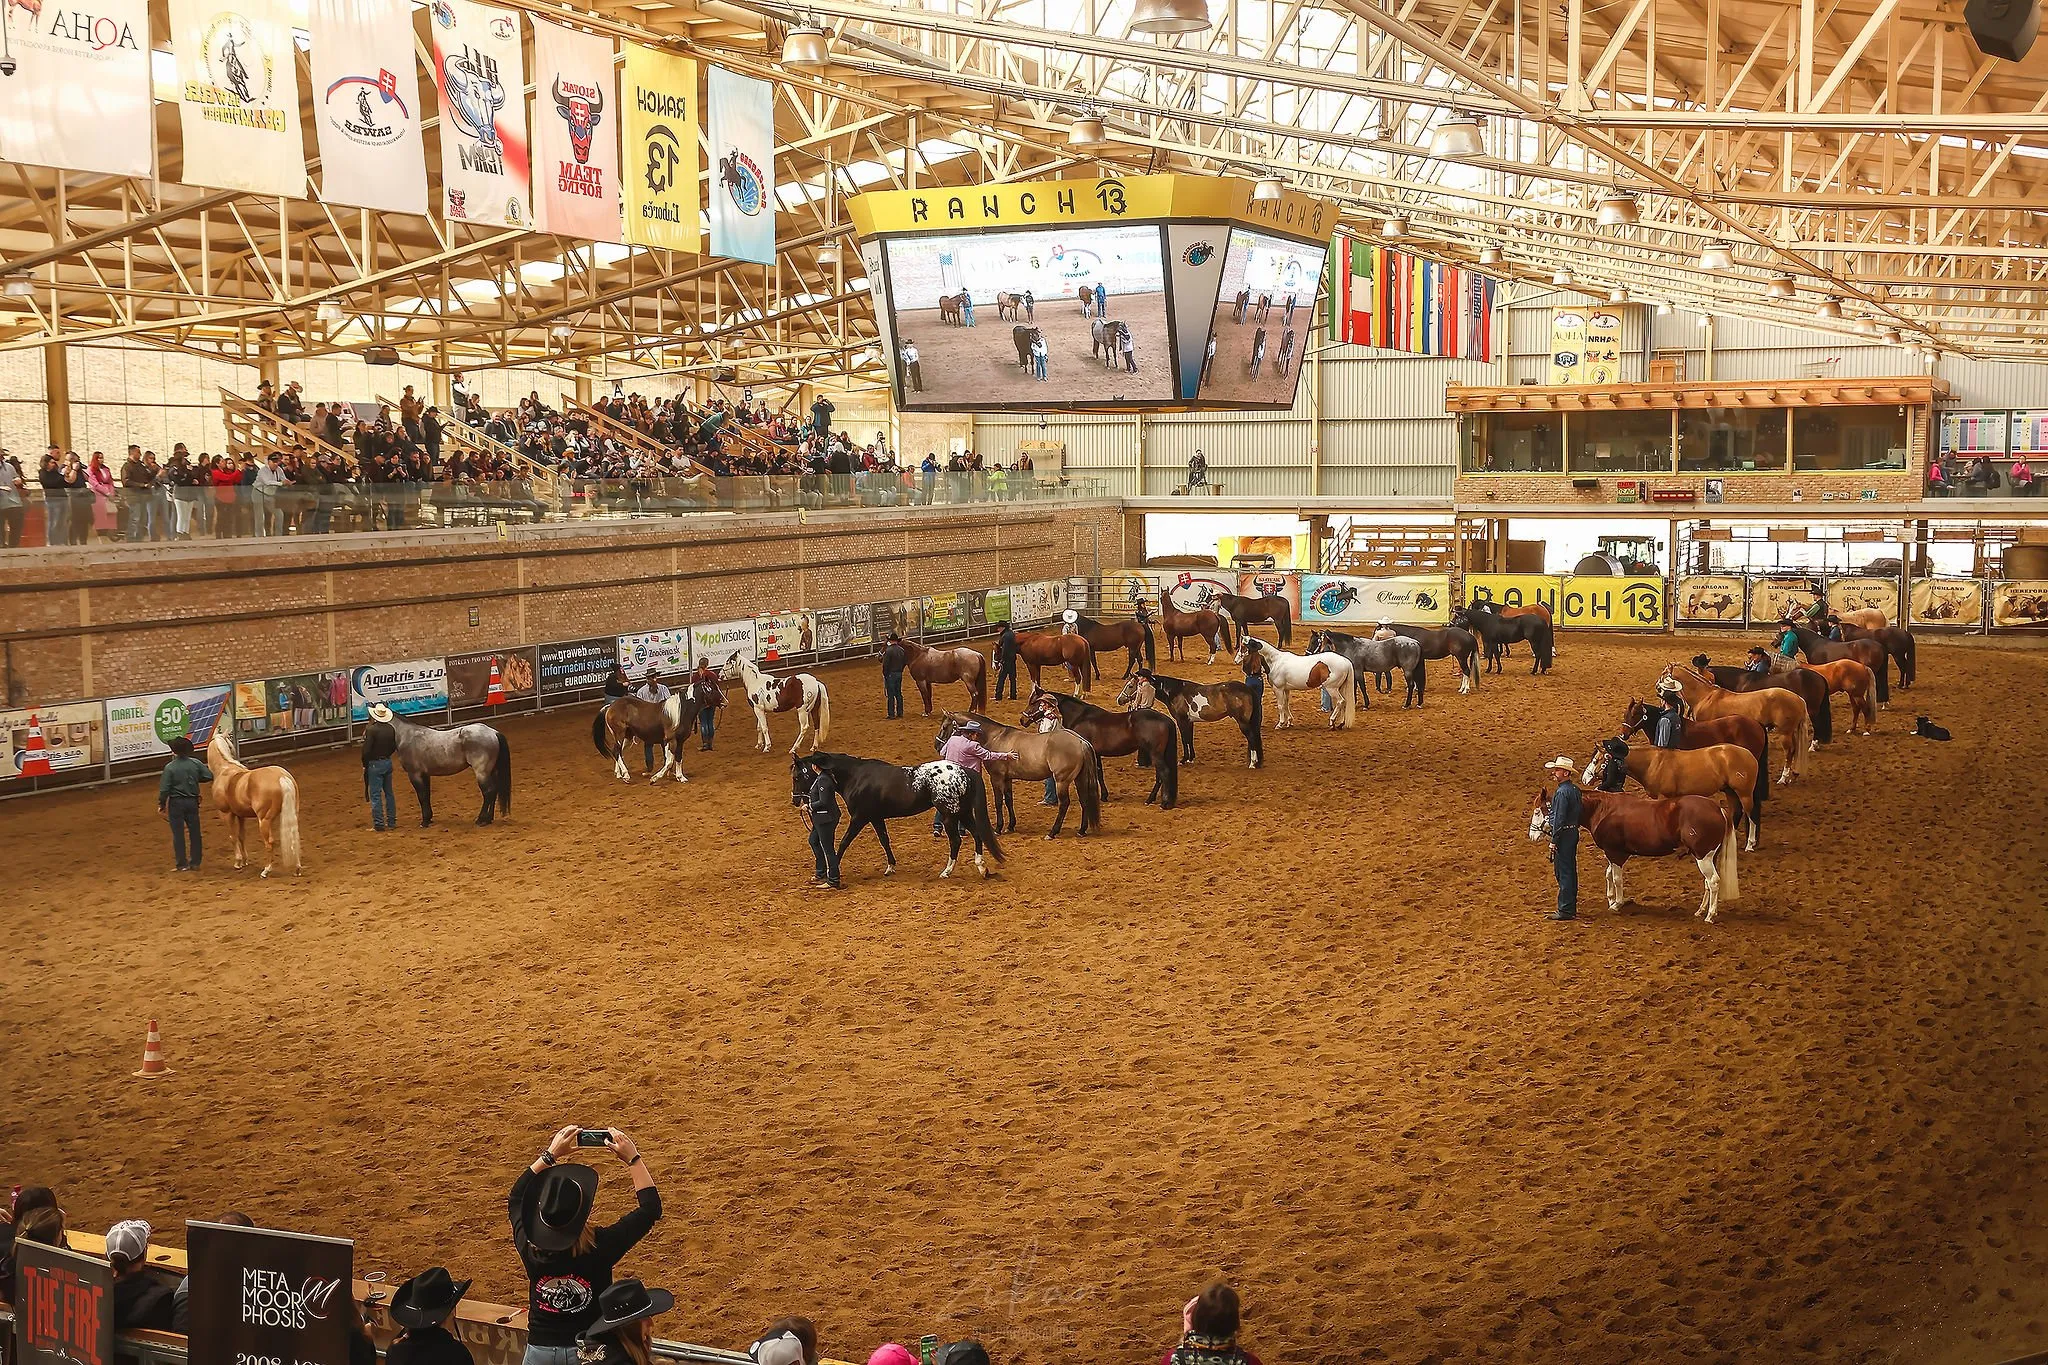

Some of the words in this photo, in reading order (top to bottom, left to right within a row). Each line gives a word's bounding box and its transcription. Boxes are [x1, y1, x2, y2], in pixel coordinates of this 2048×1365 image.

[912, 188, 1075, 223] RANCH
[1096, 185, 1128, 216] 13
[1312, 207, 1325, 236] 13
[1623, 592, 1661, 624] 13
[542, 645, 600, 662] www.graweb.com
[364, 669, 415, 687] Aquatris
[419, 668, 447, 680] s.r.o.
[111, 706, 145, 721] MARTEL
[156, 705, 190, 725] -50%
[242, 1266, 290, 1291] META
[242, 1285, 302, 1310] MOOR
[24, 1266, 59, 1344] THE
[63, 1283, 104, 1365] FIRE
[242, 1304, 306, 1330] PHOSIS
